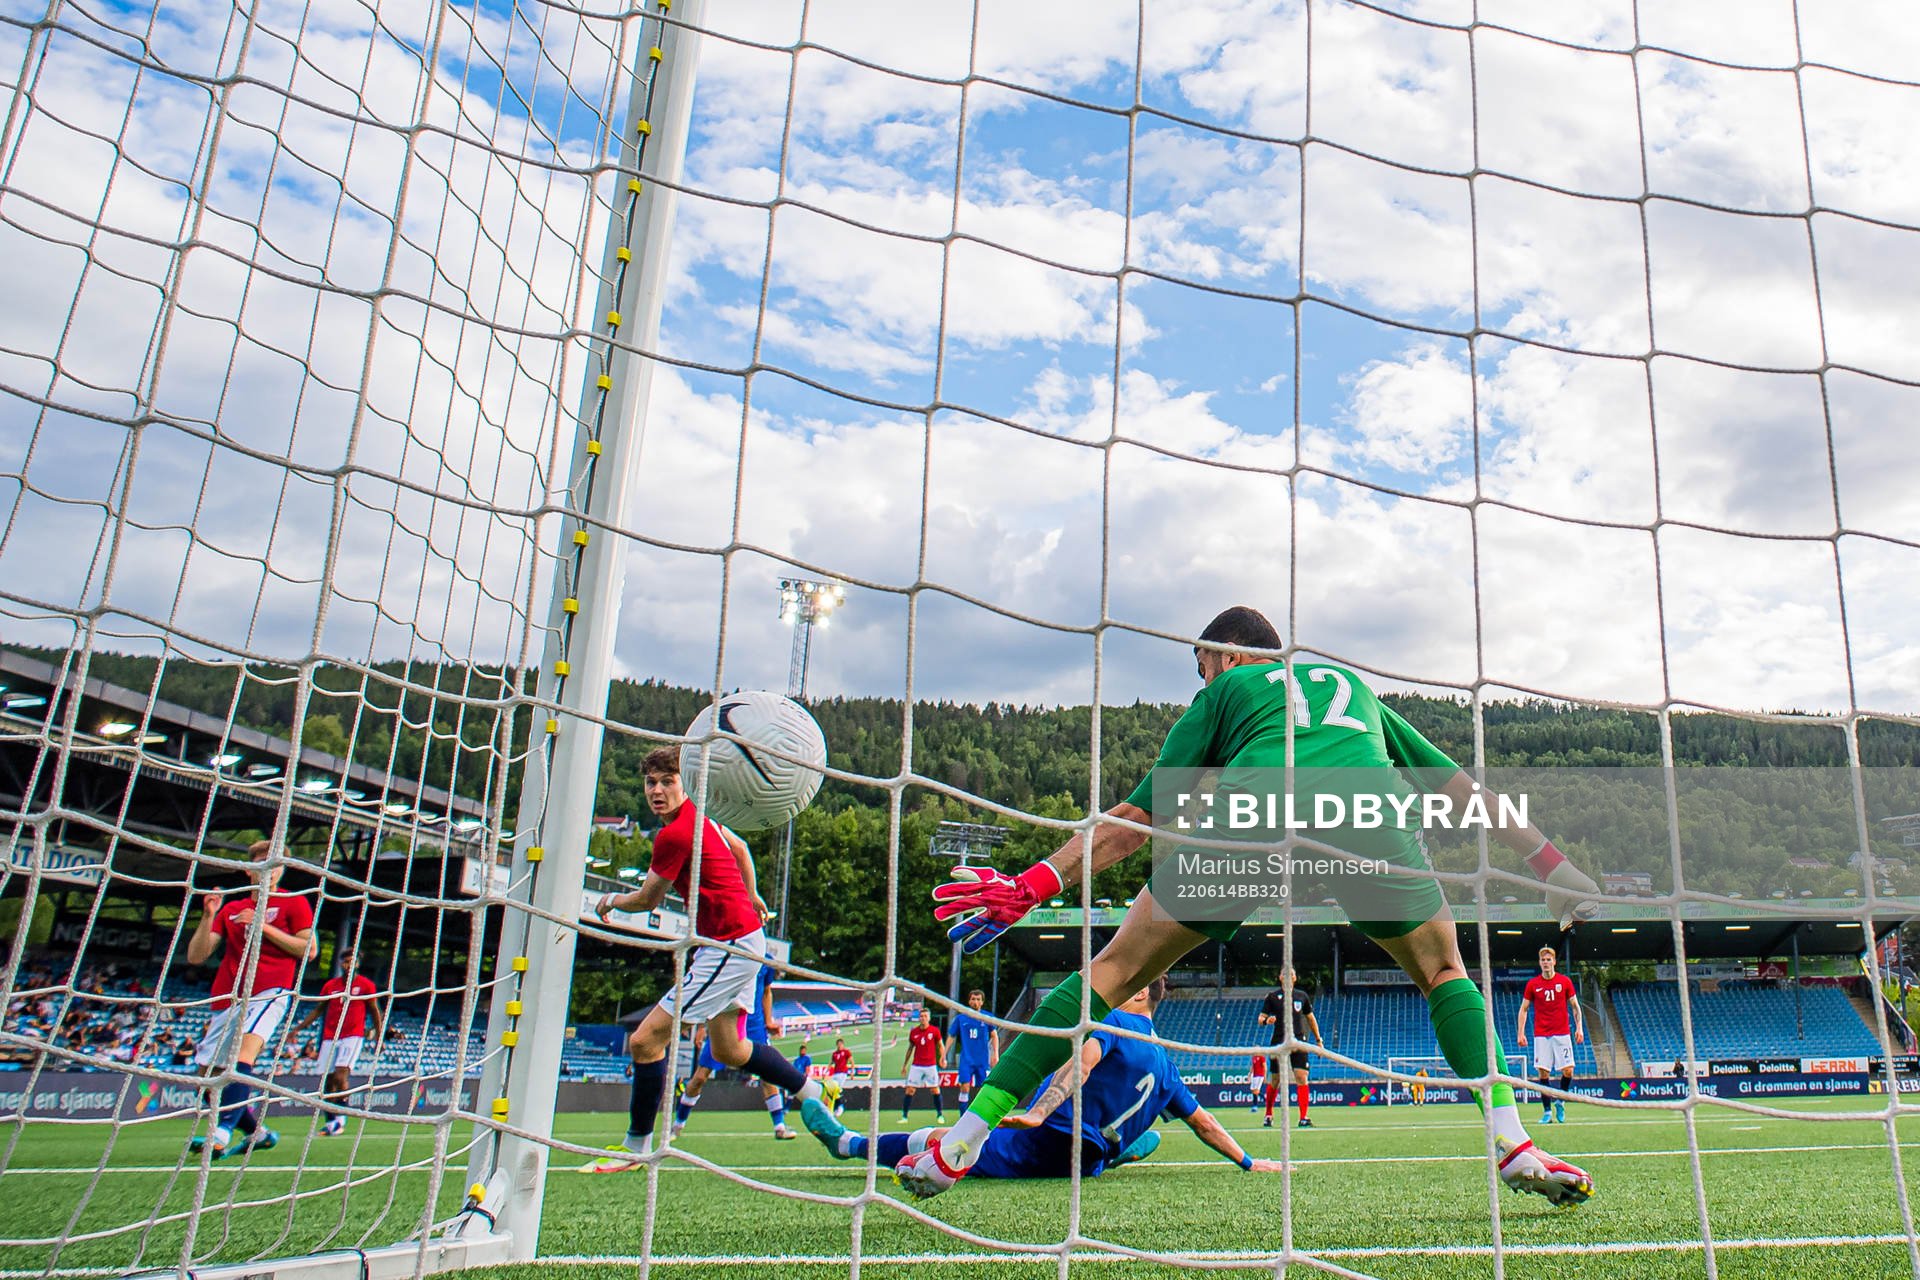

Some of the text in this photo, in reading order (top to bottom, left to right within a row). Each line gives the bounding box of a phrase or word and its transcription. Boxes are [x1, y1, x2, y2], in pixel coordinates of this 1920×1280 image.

[1265, 667, 1368, 732] 12
[1544, 989, 1555, 1001] 21
[1640, 1083, 1674, 1096] Norsk
[1738, 1078, 1861, 1093] Gi drømmen en sjanse
[1417, 1087, 1459, 1103] ipping
